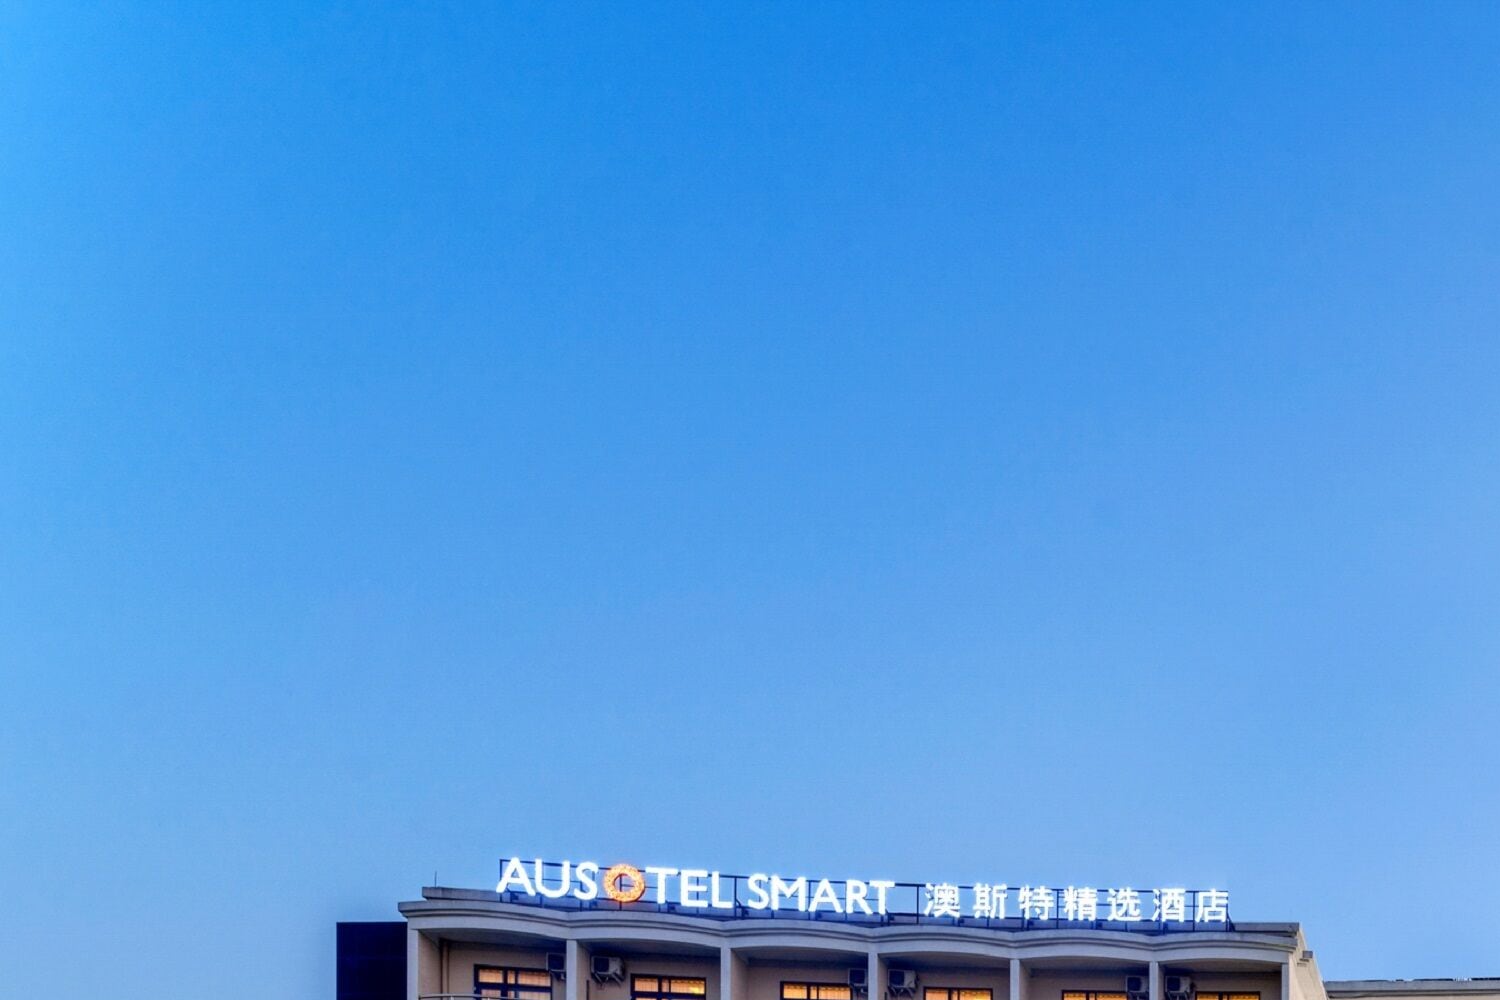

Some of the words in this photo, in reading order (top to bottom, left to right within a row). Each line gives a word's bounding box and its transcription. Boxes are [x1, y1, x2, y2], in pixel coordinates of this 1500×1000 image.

[495, 857, 733, 910] AUSOTEL
[746, 874, 896, 916] SMART
[923, 882, 1229, 923] 澳斯特精选酒店
